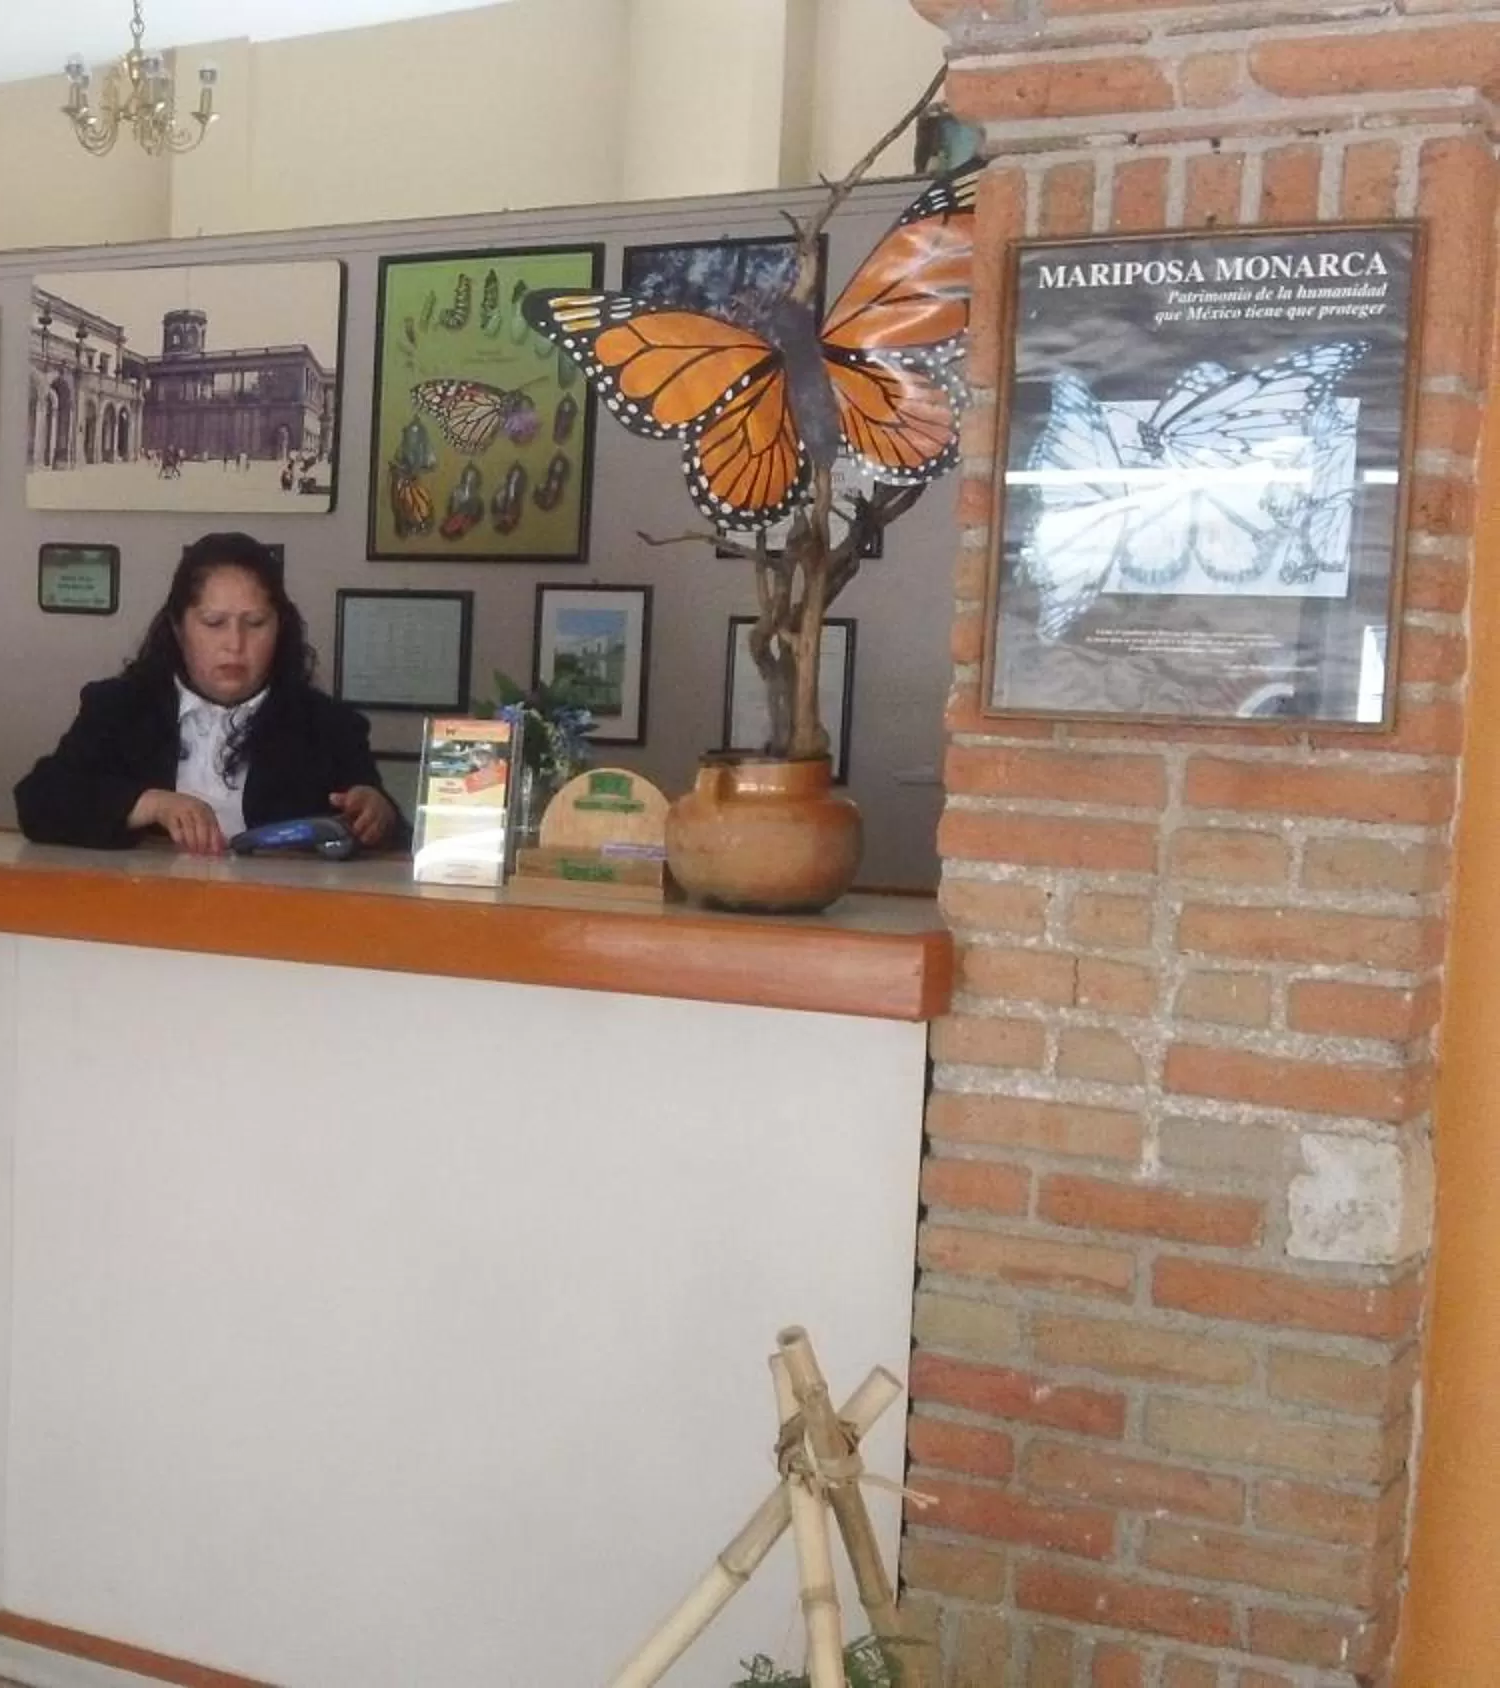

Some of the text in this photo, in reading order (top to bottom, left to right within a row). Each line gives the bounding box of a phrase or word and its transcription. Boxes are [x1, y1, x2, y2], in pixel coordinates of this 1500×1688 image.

[1038, 251, 1388, 289] MARIPOSA MONARCA
[1168, 282, 1388, 304] Patrimonio de la humanidad
[1155, 303, 1386, 325] que México tiene que proteger
